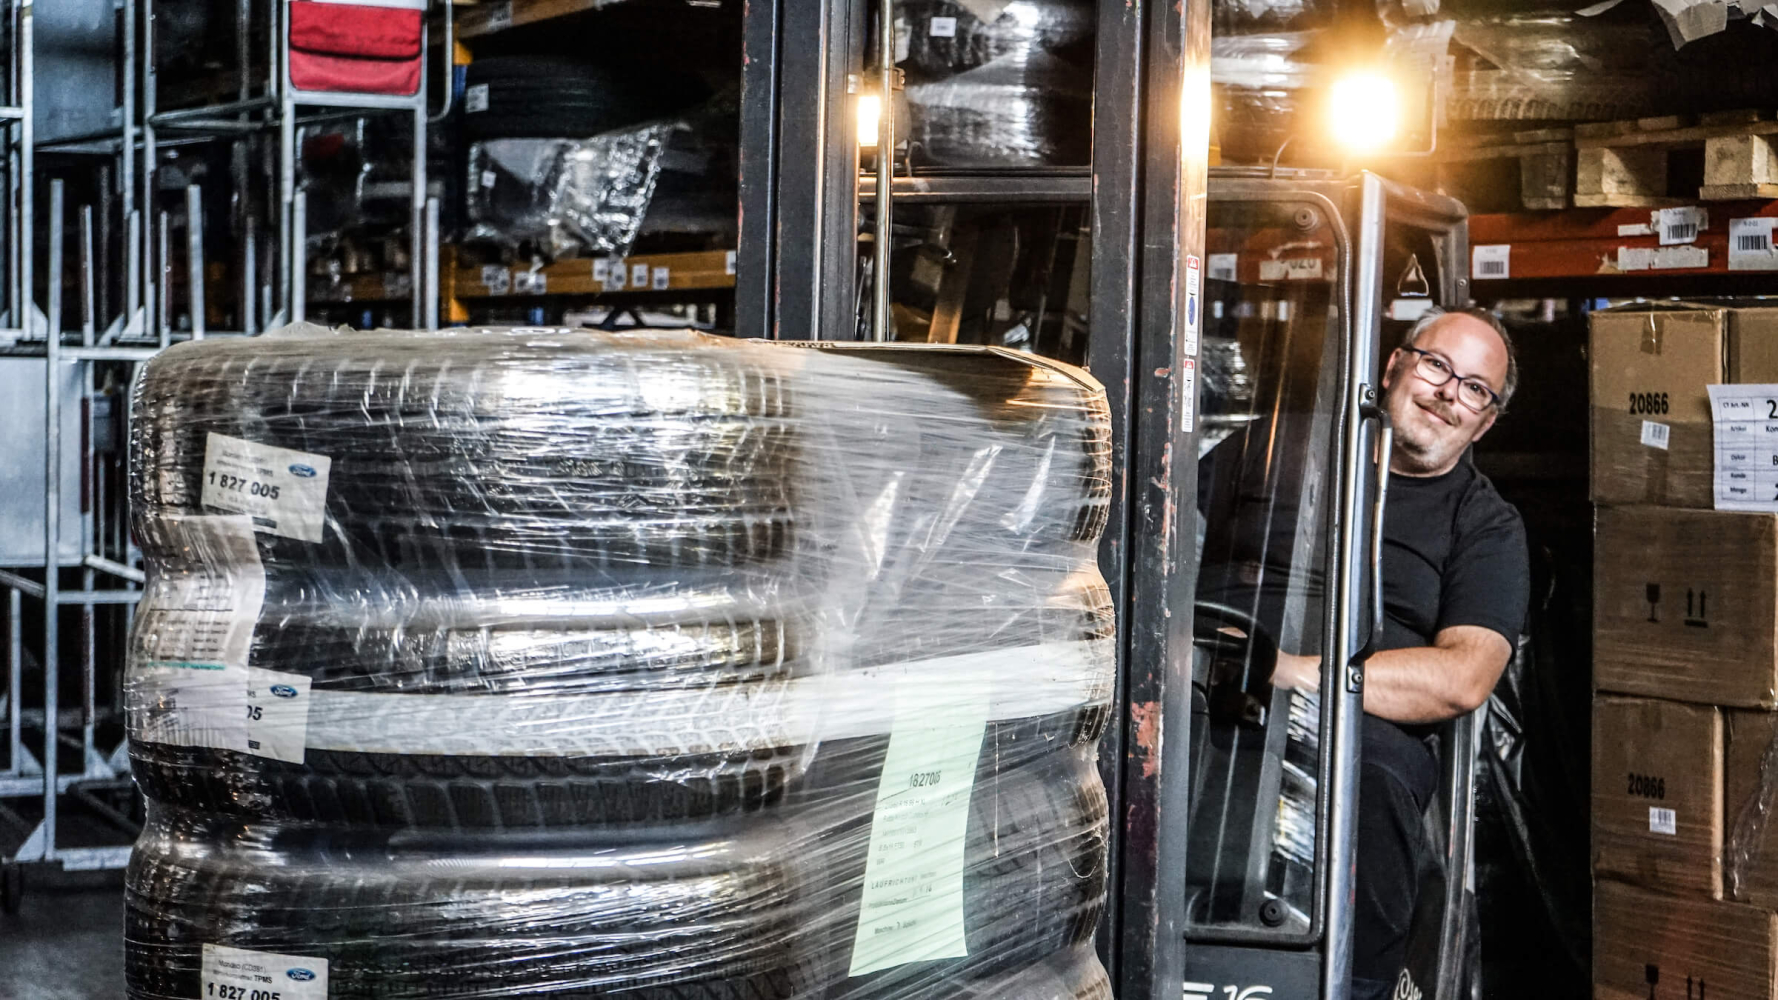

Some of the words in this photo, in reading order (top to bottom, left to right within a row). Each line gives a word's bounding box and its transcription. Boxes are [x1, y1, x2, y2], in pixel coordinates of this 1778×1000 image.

[1629, 392, 1669, 414] 20866
[209, 471, 216, 485] 1
[220, 474, 246, 492] 827
[251, 482, 280, 500] 005
[1628, 772, 1665, 800] 20866
[254, 975, 272, 984] TPMS
[208, 982, 215, 996] 1
[219, 985, 246, 1000] 827
